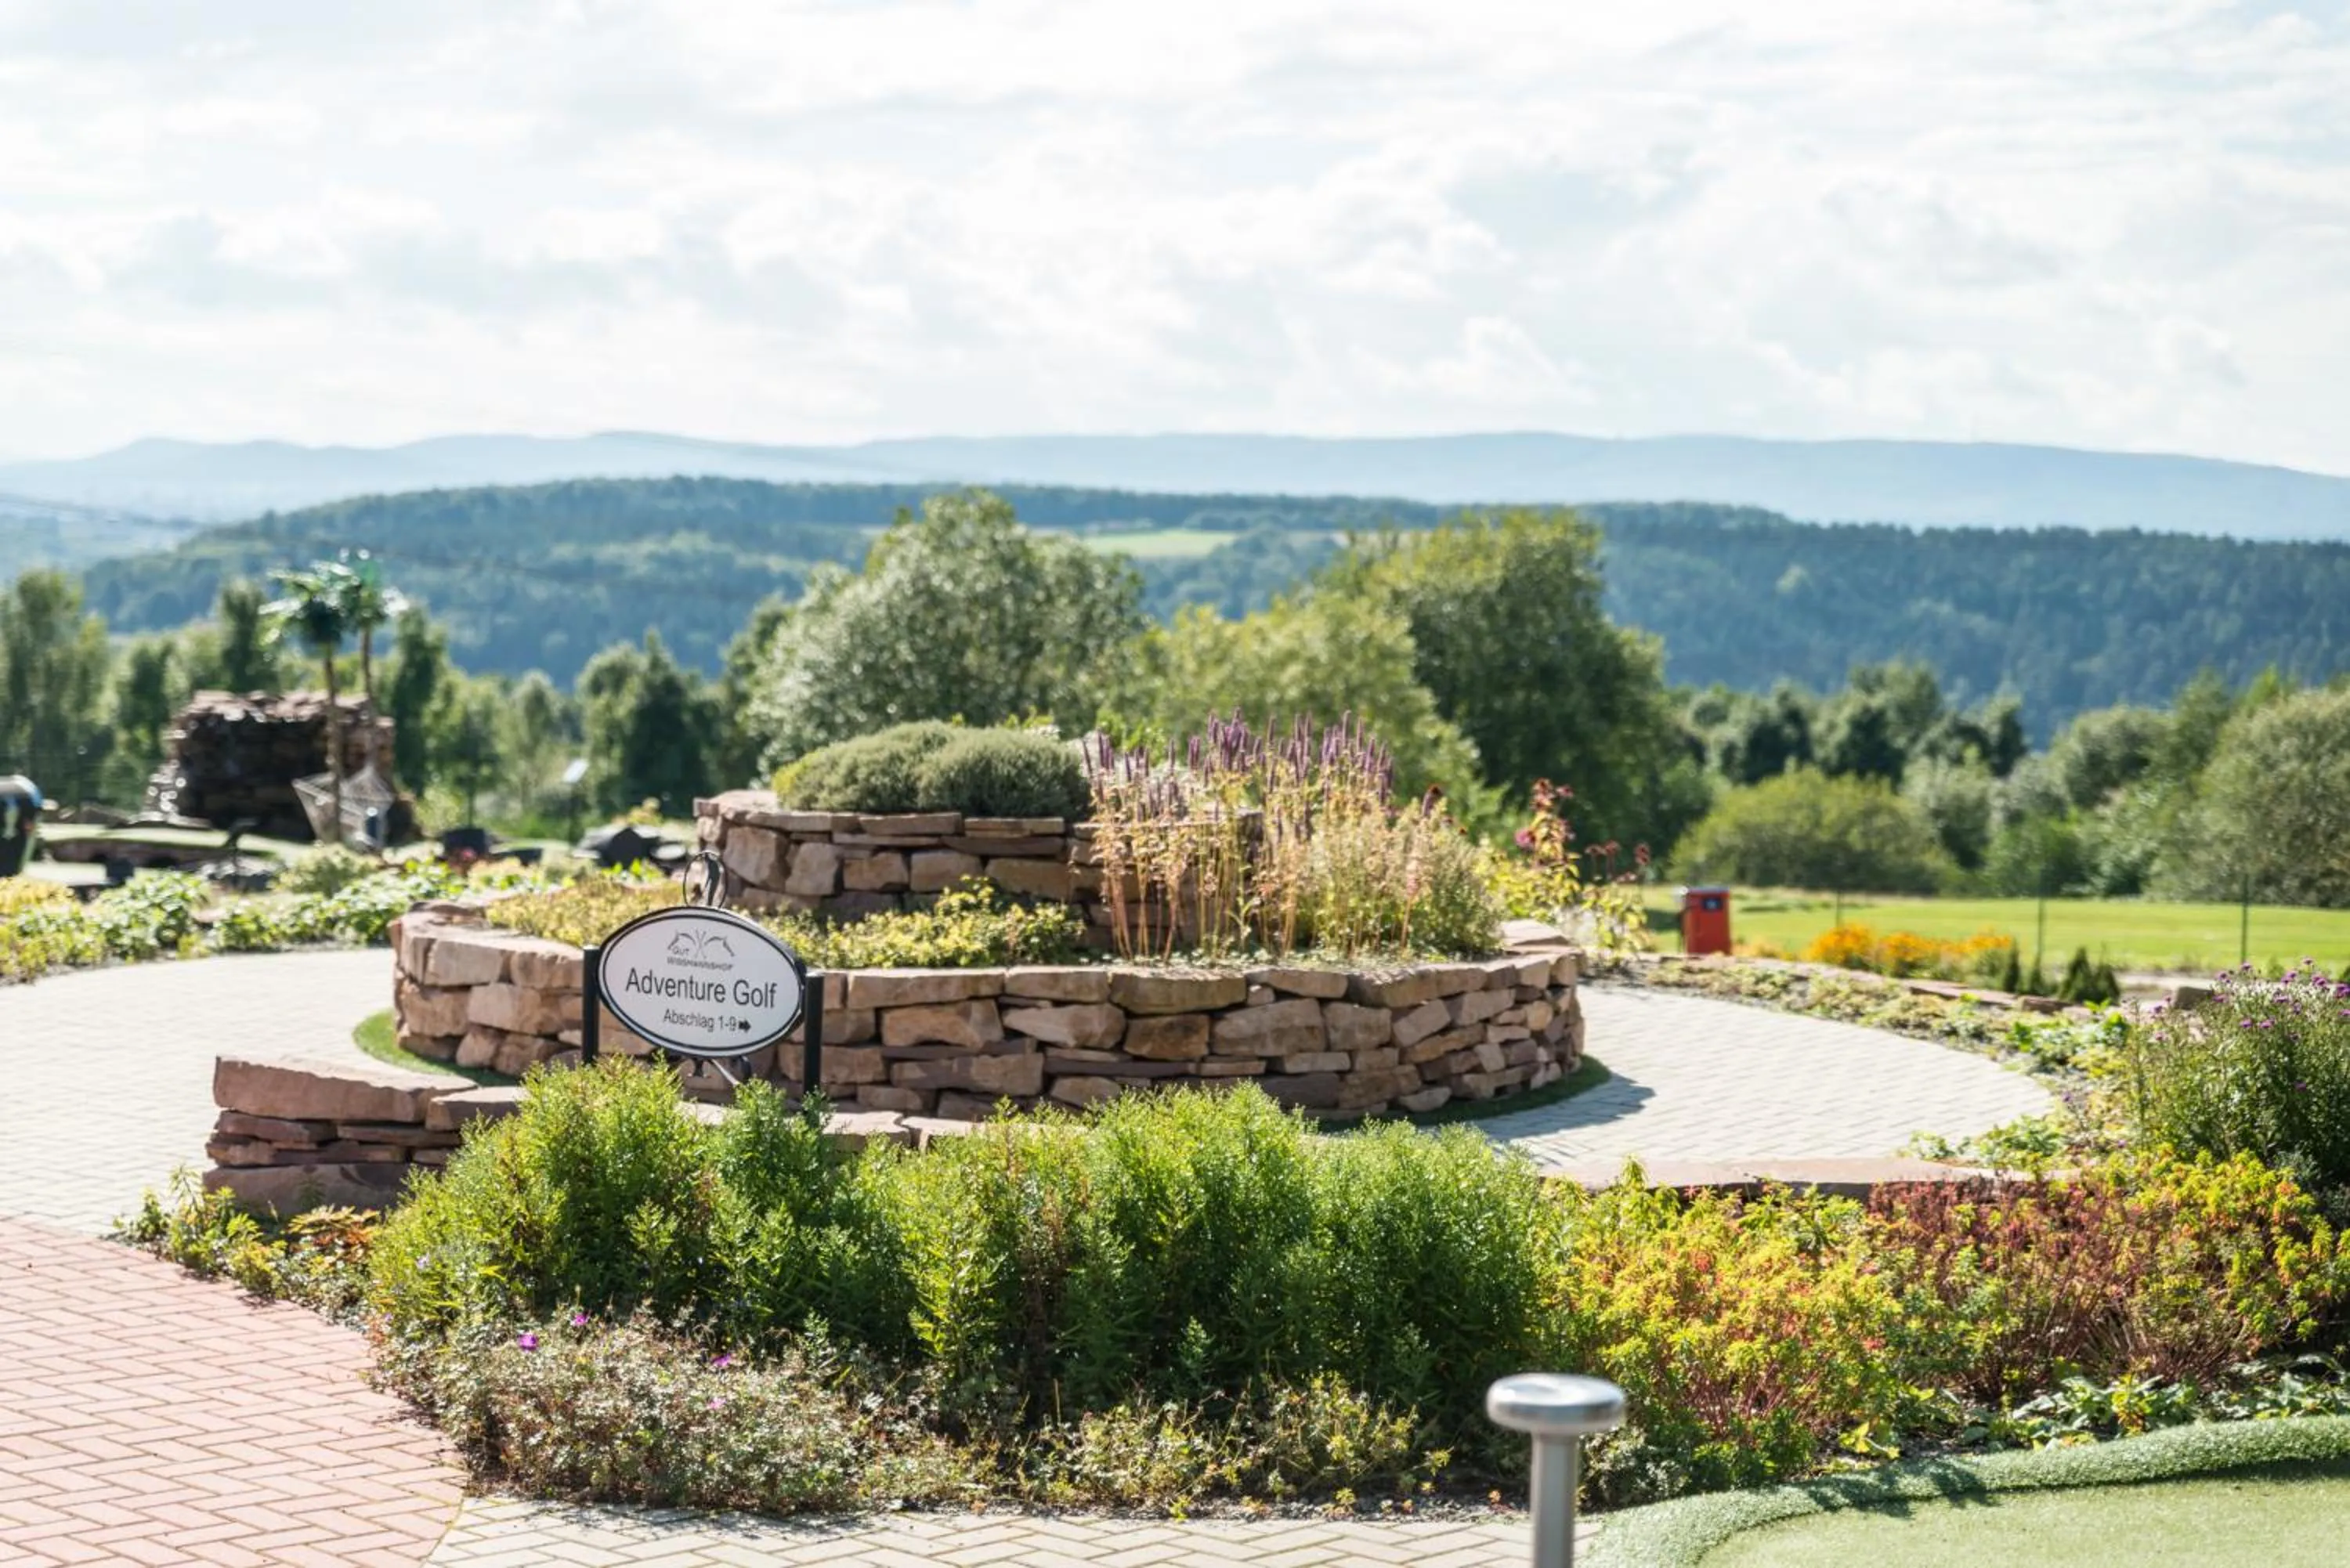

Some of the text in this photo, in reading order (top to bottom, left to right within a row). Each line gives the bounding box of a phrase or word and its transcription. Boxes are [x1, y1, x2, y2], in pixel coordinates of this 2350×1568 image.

[672, 946, 690, 956] GUT
[626, 968, 777, 1008] Adventure Golf
[663, 1009, 737, 1032] Abschlag 1-9
